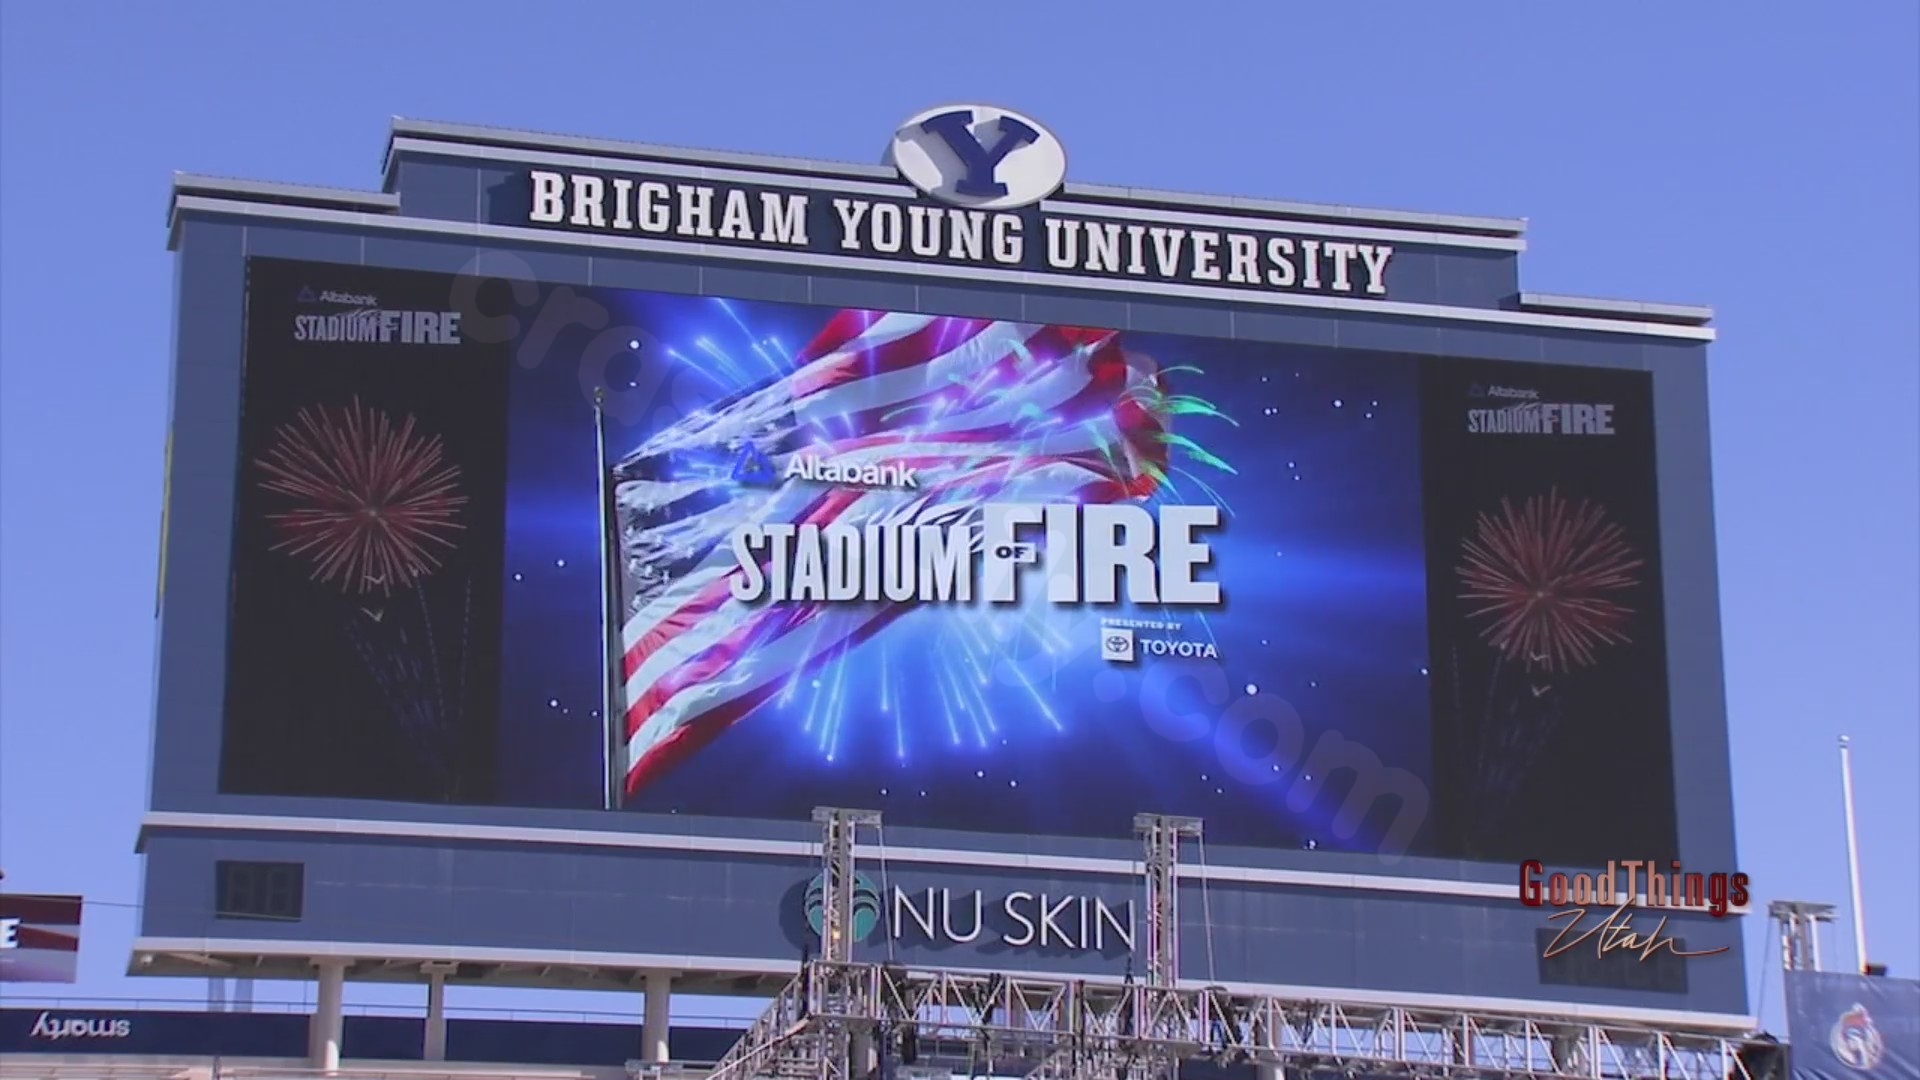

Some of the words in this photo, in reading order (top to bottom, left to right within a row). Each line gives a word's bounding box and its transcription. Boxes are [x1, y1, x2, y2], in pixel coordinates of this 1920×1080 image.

[920, 109, 1040, 198] Y
[529, 169, 809, 246] BRIGHAM
[833, 198, 1024, 265] YOUNG
[1045, 217, 1394, 295] UNIVERSITY
[294, 314, 376, 342] STADIUM
[379, 309, 461, 345] FIRE
[1468, 407, 1540, 434] STADIUM
[1542, 403, 1615, 435] FIRE
[784, 453, 917, 488] Altabank
[730, 522, 972, 602] STADIUM
[983, 503, 1220, 604] FIRE
[995, 545, 1029, 560] OF
[1140, 638, 1218, 659] TOYOTA
[893, 884, 982, 943] NU
[1003, 891, 1136, 951] SKIN
[30, 1011, 131, 1040] smarty
